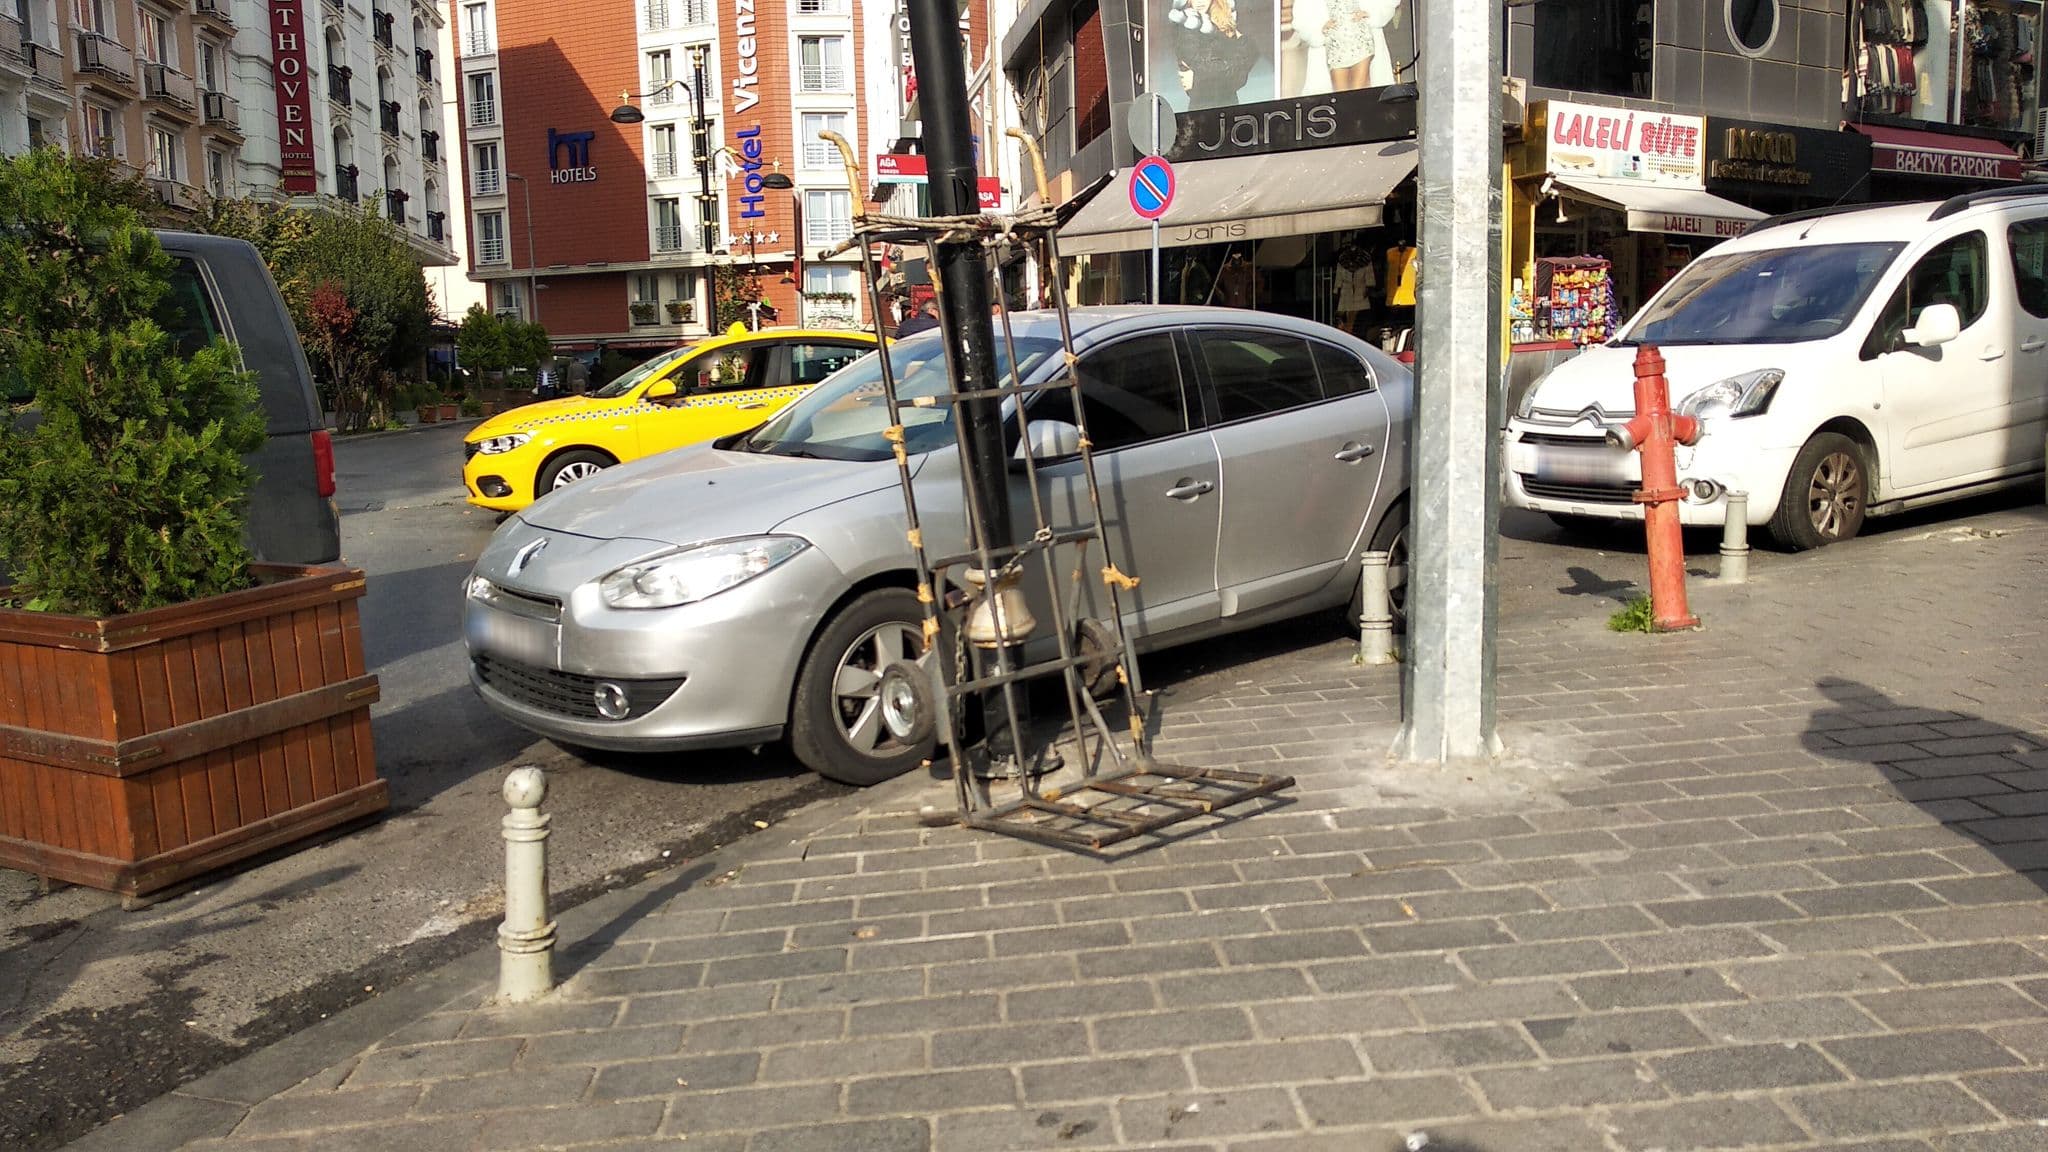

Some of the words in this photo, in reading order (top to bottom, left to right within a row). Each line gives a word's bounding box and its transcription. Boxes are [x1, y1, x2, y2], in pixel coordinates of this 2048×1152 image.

[898, 0, 912, 66] HOTE
[275, 0, 305, 146] THOVEN
[1639, 116, 1699, 157] BÜFE
[550, 166, 597, 184] HOTELS
[736, 125, 765, 218] Hotel
[1950, 155, 2001, 178] EXPORT
